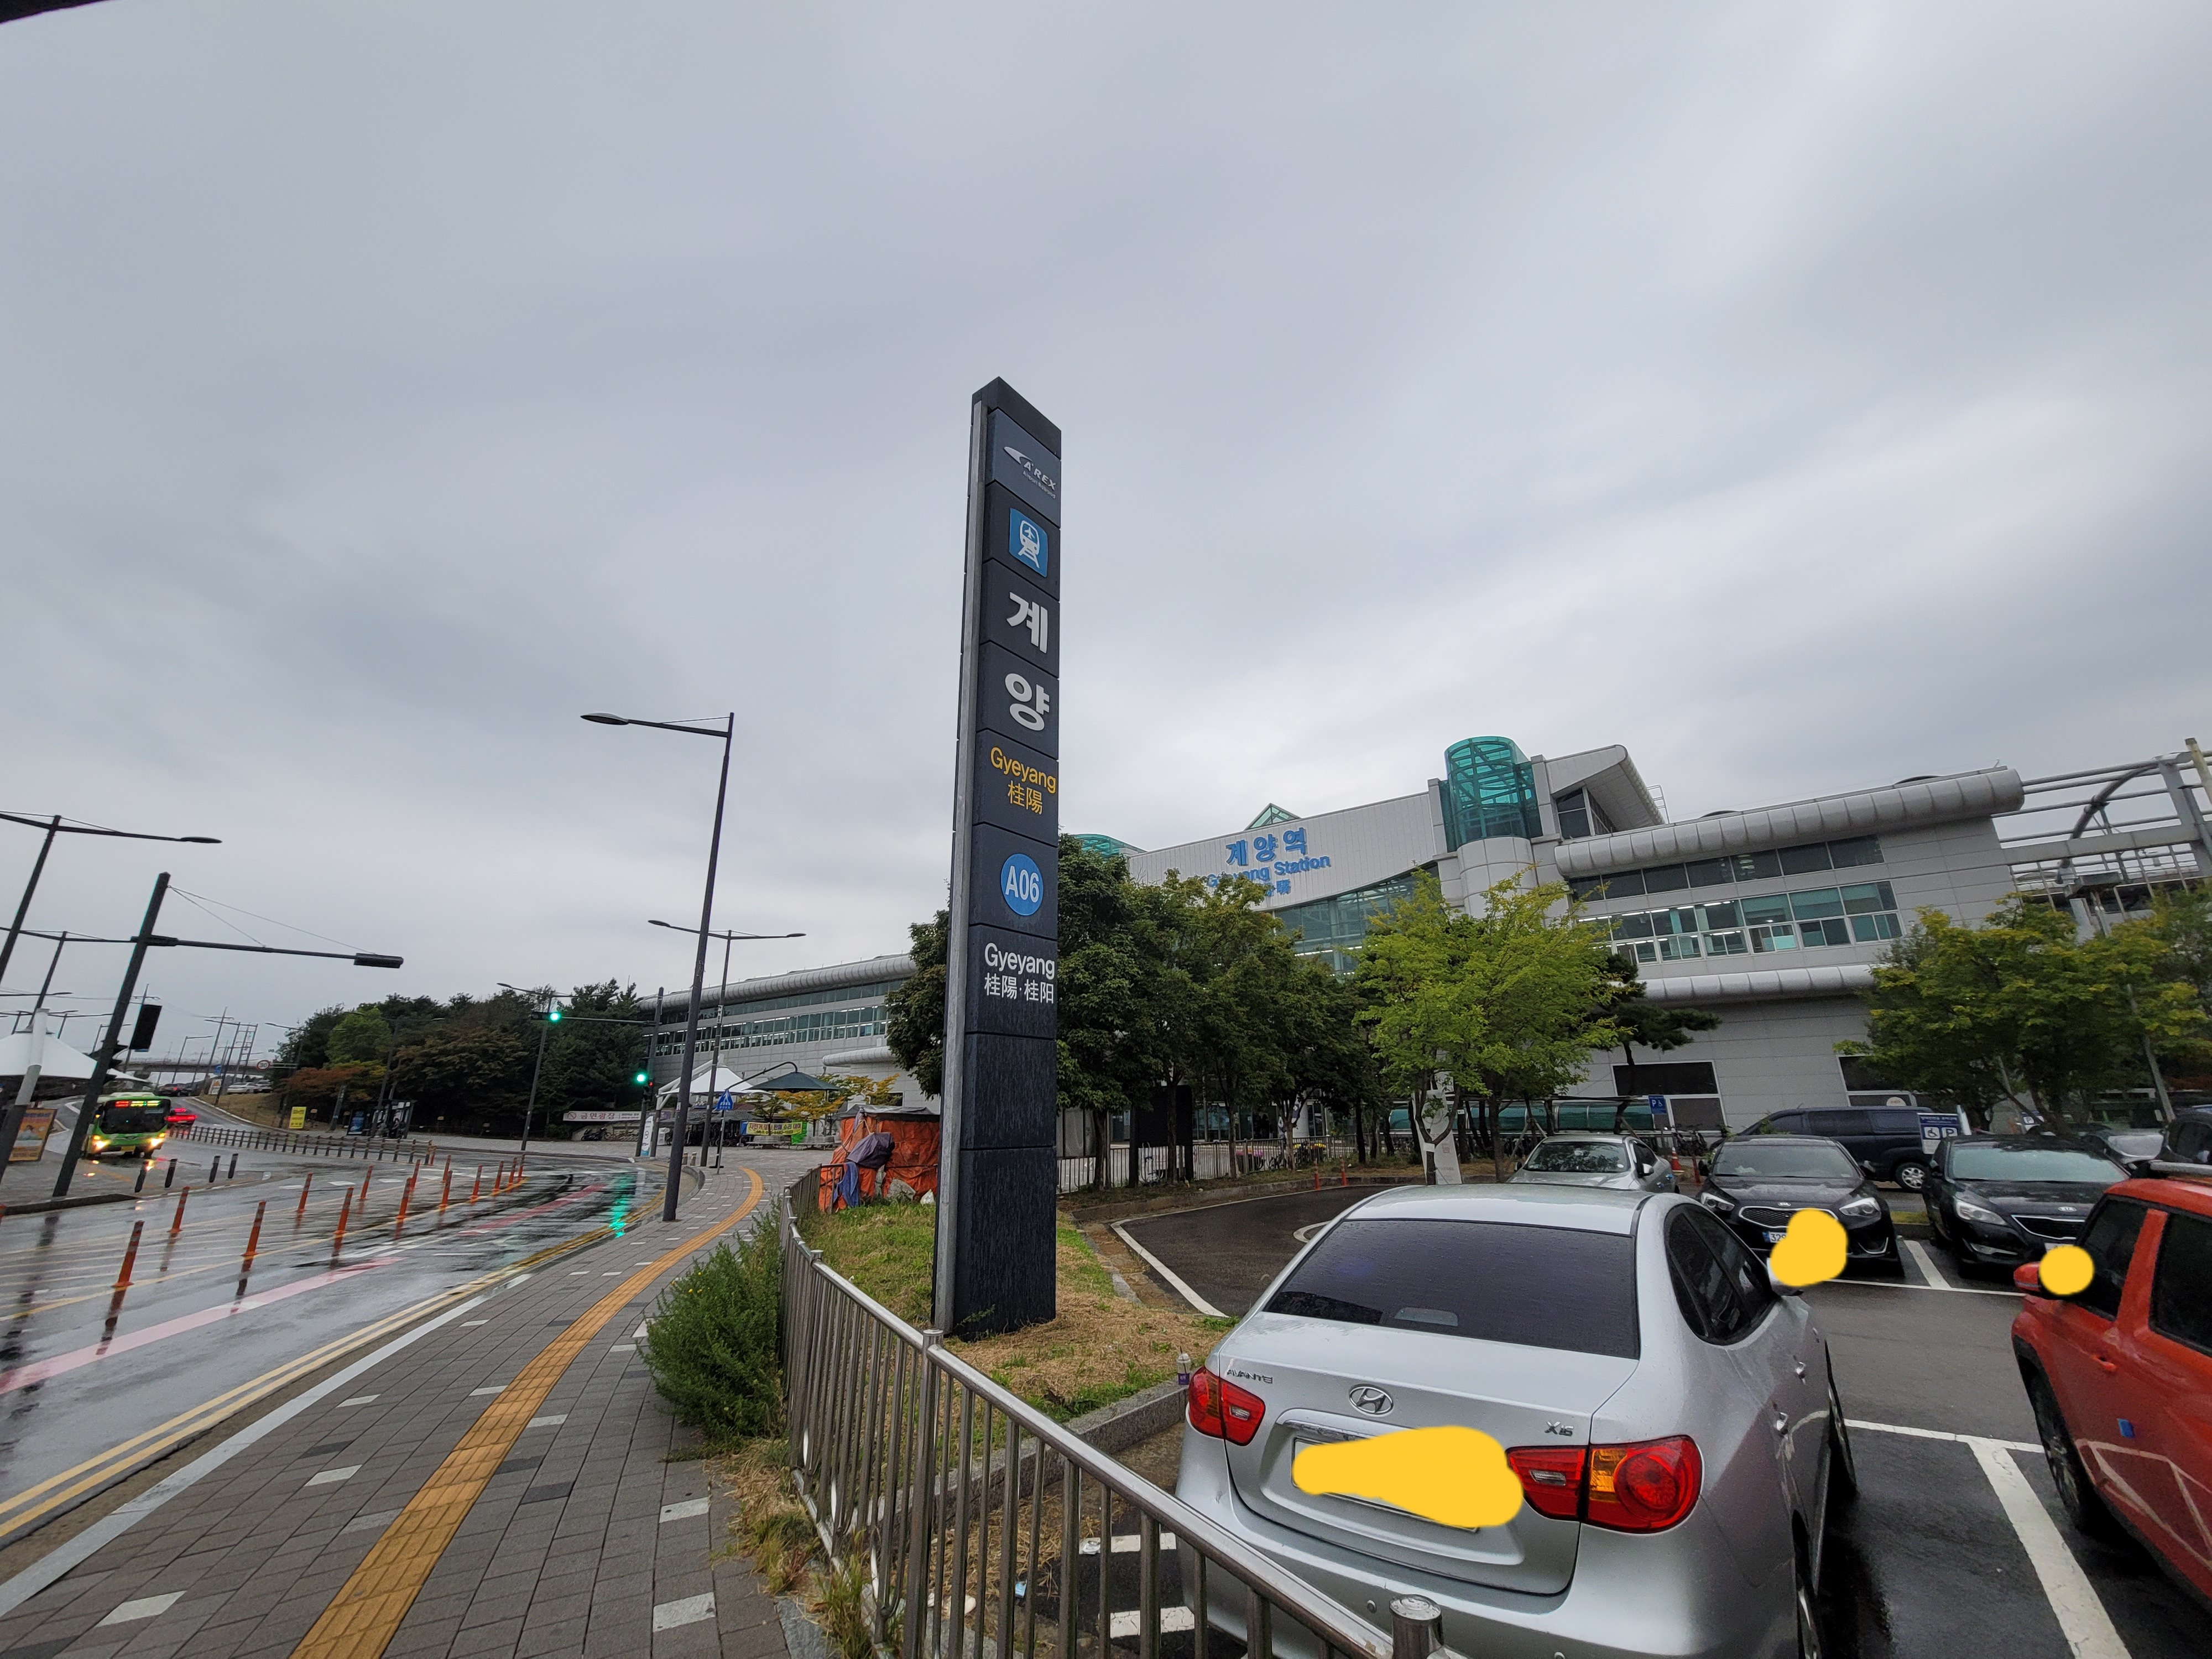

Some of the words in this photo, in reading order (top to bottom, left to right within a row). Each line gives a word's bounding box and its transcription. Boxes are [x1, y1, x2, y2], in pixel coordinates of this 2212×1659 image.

[1004, 591, 1050, 731] 계양
[990, 747, 1057, 795] Gyeyang
[1007, 780, 1043, 816] 桂陽
[1225, 827, 1307, 867] 계양역
[1004, 865, 1040, 902] A06
[1207, 867, 1271, 888] Gang
[1274, 855, 1331, 875] Station
[984, 942, 1055, 980] Gyeyang
[1227, 1369, 1273, 1384] AVANTE
